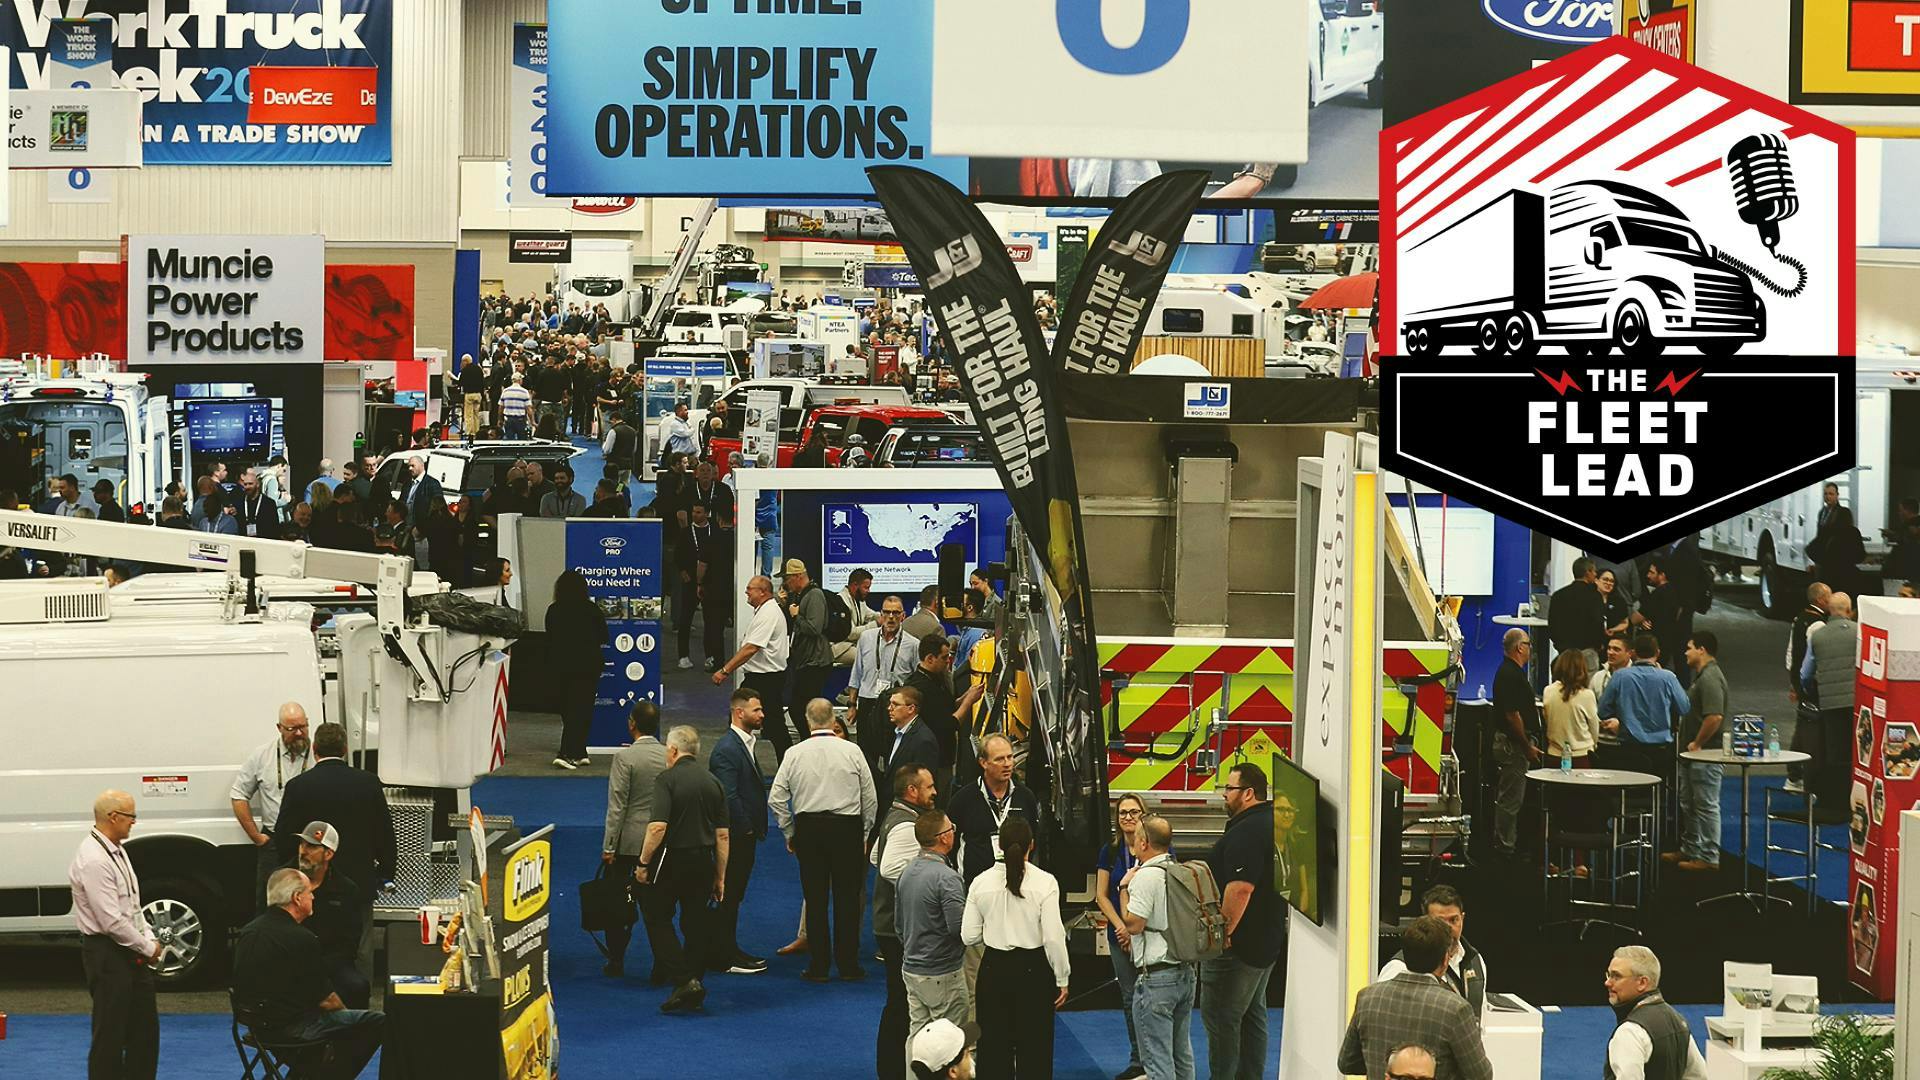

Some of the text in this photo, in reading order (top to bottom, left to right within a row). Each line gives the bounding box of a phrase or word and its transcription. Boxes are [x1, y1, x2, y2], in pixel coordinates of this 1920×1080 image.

[73, 26, 91, 34] THE
[67, 43, 97, 51] TRUCK
[67, 52, 96, 60] SHOW
[643, 46, 878, 100] SIMPLIFY
[171, 125, 188, 143] A
[198, 125, 276, 143] TRADE
[286, 125, 363, 144] SHOW
[595, 103, 924, 160] OPERATIONS.
[147, 248, 273, 279] Muncie
[147, 284, 258, 316] Power
[1086, 263, 1126, 309] THE
[147, 321, 304, 352] Products
[1069, 309, 1107, 358] FOR
[1101, 295, 1146, 355] HAUL
[941, 295, 1034, 489] BUILT FOR THE
[981, 297, 1050, 459] LONG HAUL
[8, 522, 57, 541] VERSALIFT
[575, 566, 651, 577] Charging Where
[585, 578, 641, 587] You Need It
[1321, 529, 1335, 747] expect
[513, 850, 544, 901] Flink
